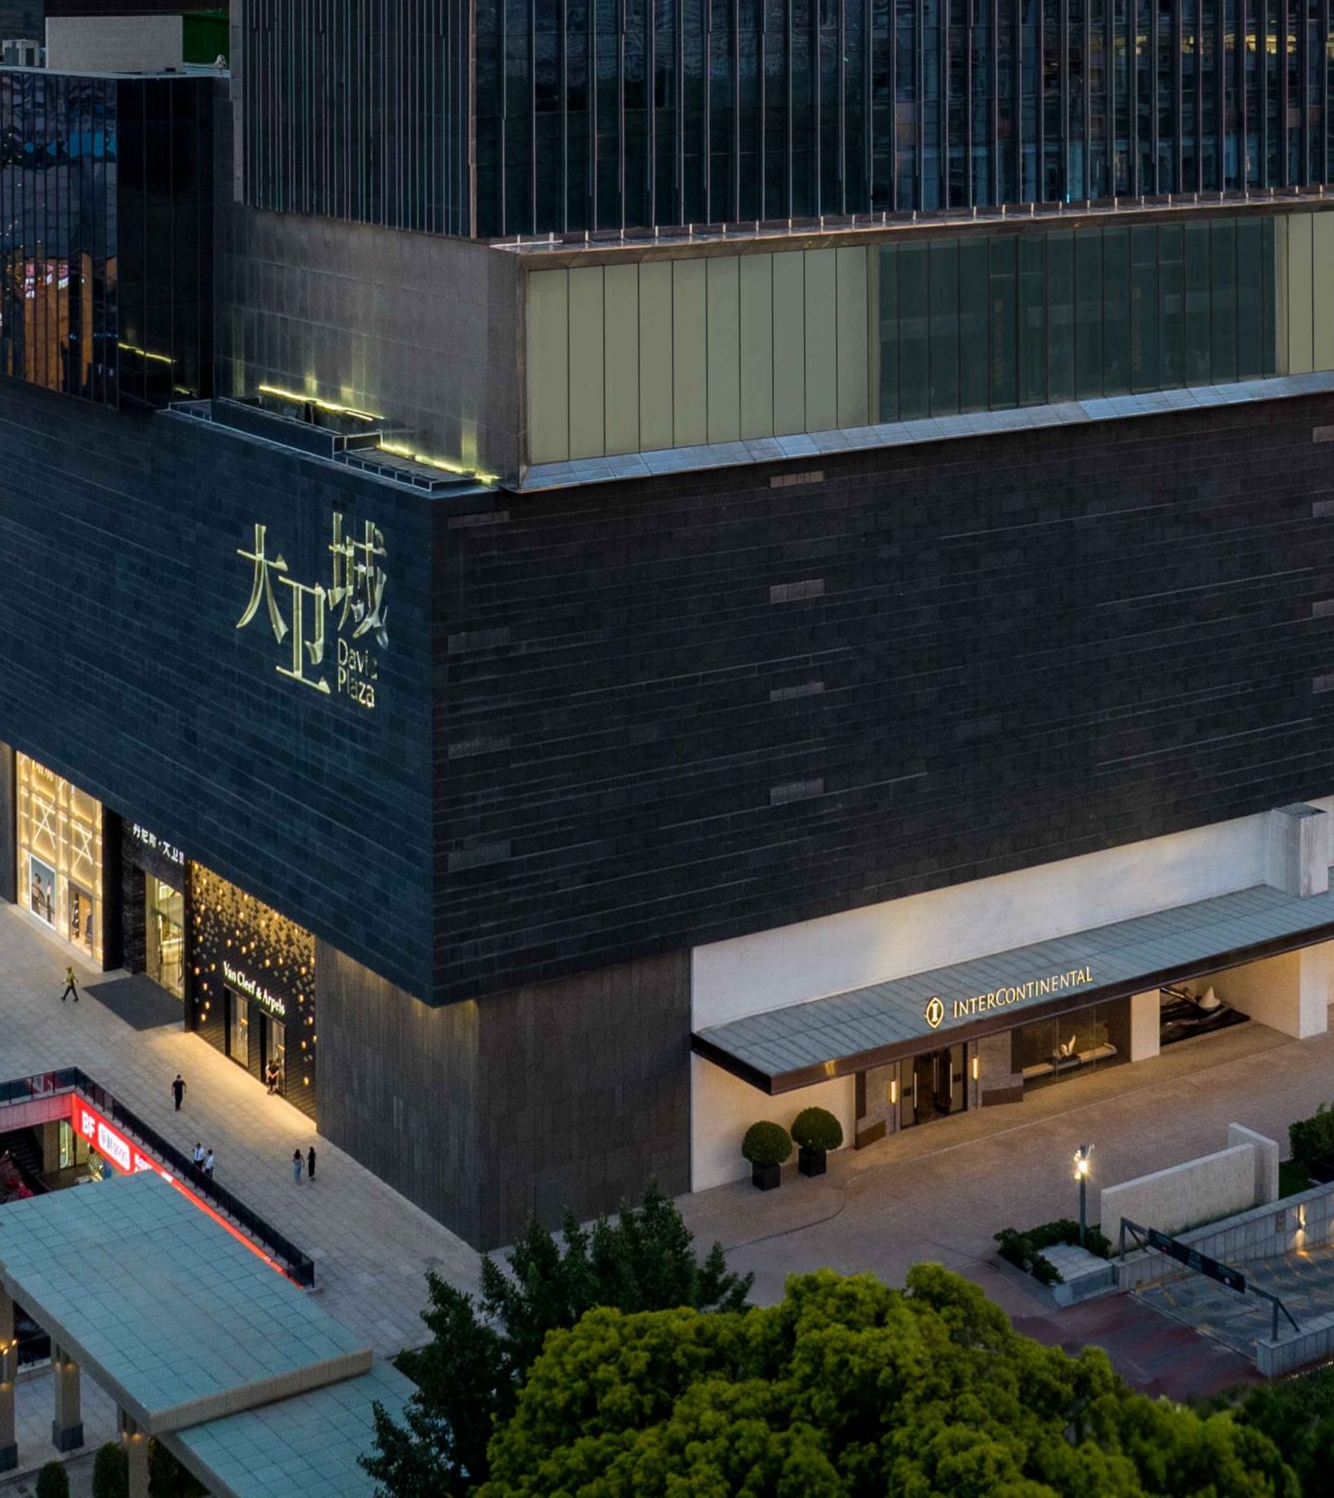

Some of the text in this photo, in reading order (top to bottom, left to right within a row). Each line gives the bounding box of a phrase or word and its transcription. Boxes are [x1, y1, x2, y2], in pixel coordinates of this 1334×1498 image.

[337, 665, 376, 708] Plaza
[223, 961, 285, 1017] Van Cleef & Arpels
